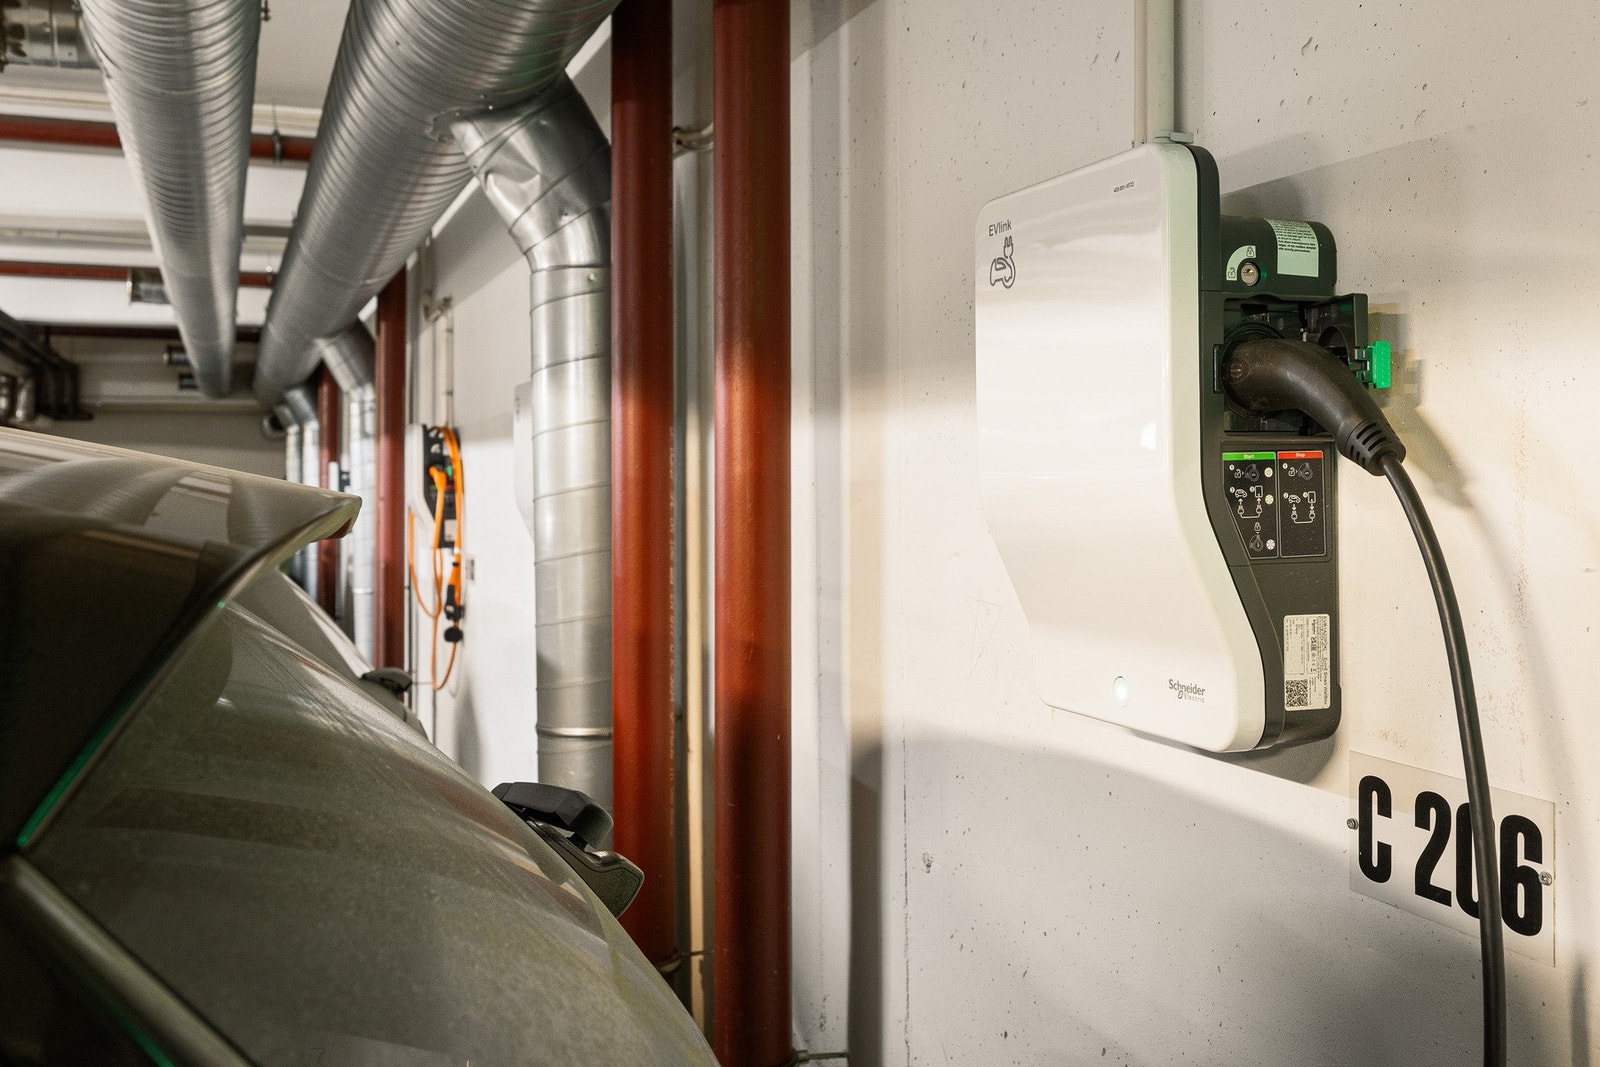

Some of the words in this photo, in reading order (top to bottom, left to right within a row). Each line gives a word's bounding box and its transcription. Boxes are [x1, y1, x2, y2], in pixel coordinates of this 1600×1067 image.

[988, 219, 1012, 237] EVlink
[1168, 678, 1205, 696] Schneider
[1184, 692, 1205, 703] Electric
[1358, 775, 1392, 884] C
